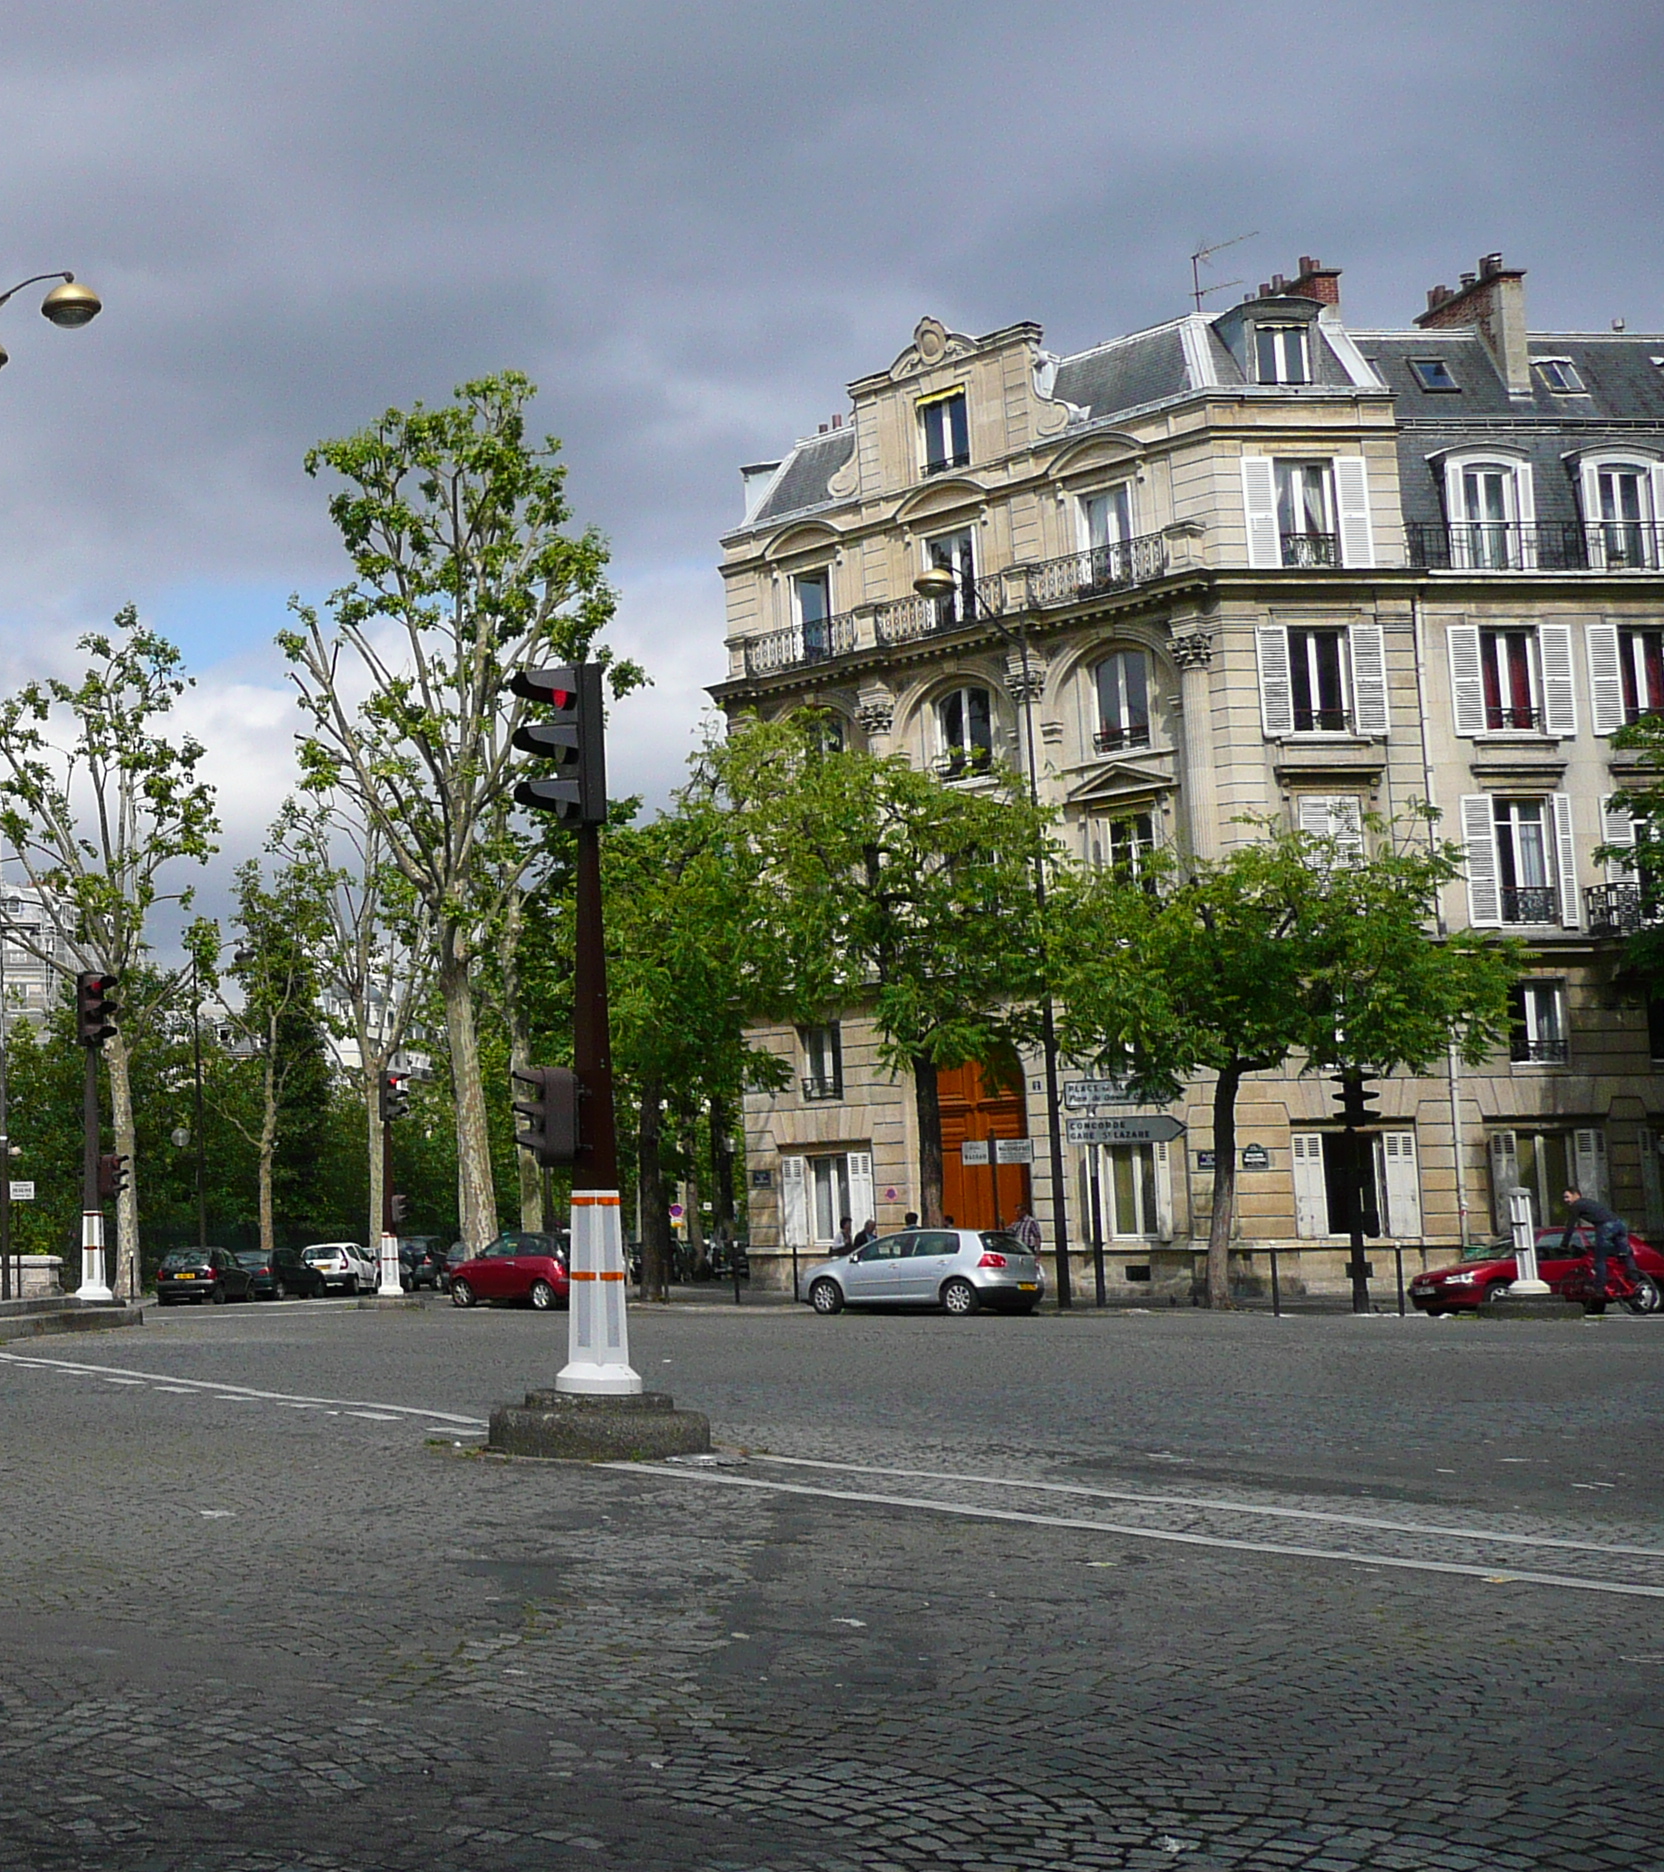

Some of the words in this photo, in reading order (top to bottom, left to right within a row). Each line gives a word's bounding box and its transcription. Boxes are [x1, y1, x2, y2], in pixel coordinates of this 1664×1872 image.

[1068, 1084, 1098, 1093] PLACE
[1070, 1121, 1126, 1130] CONCORDE
[1070, 1131, 1095, 1140] GARE
[1114, 1130, 1150, 1138] LAZARE
